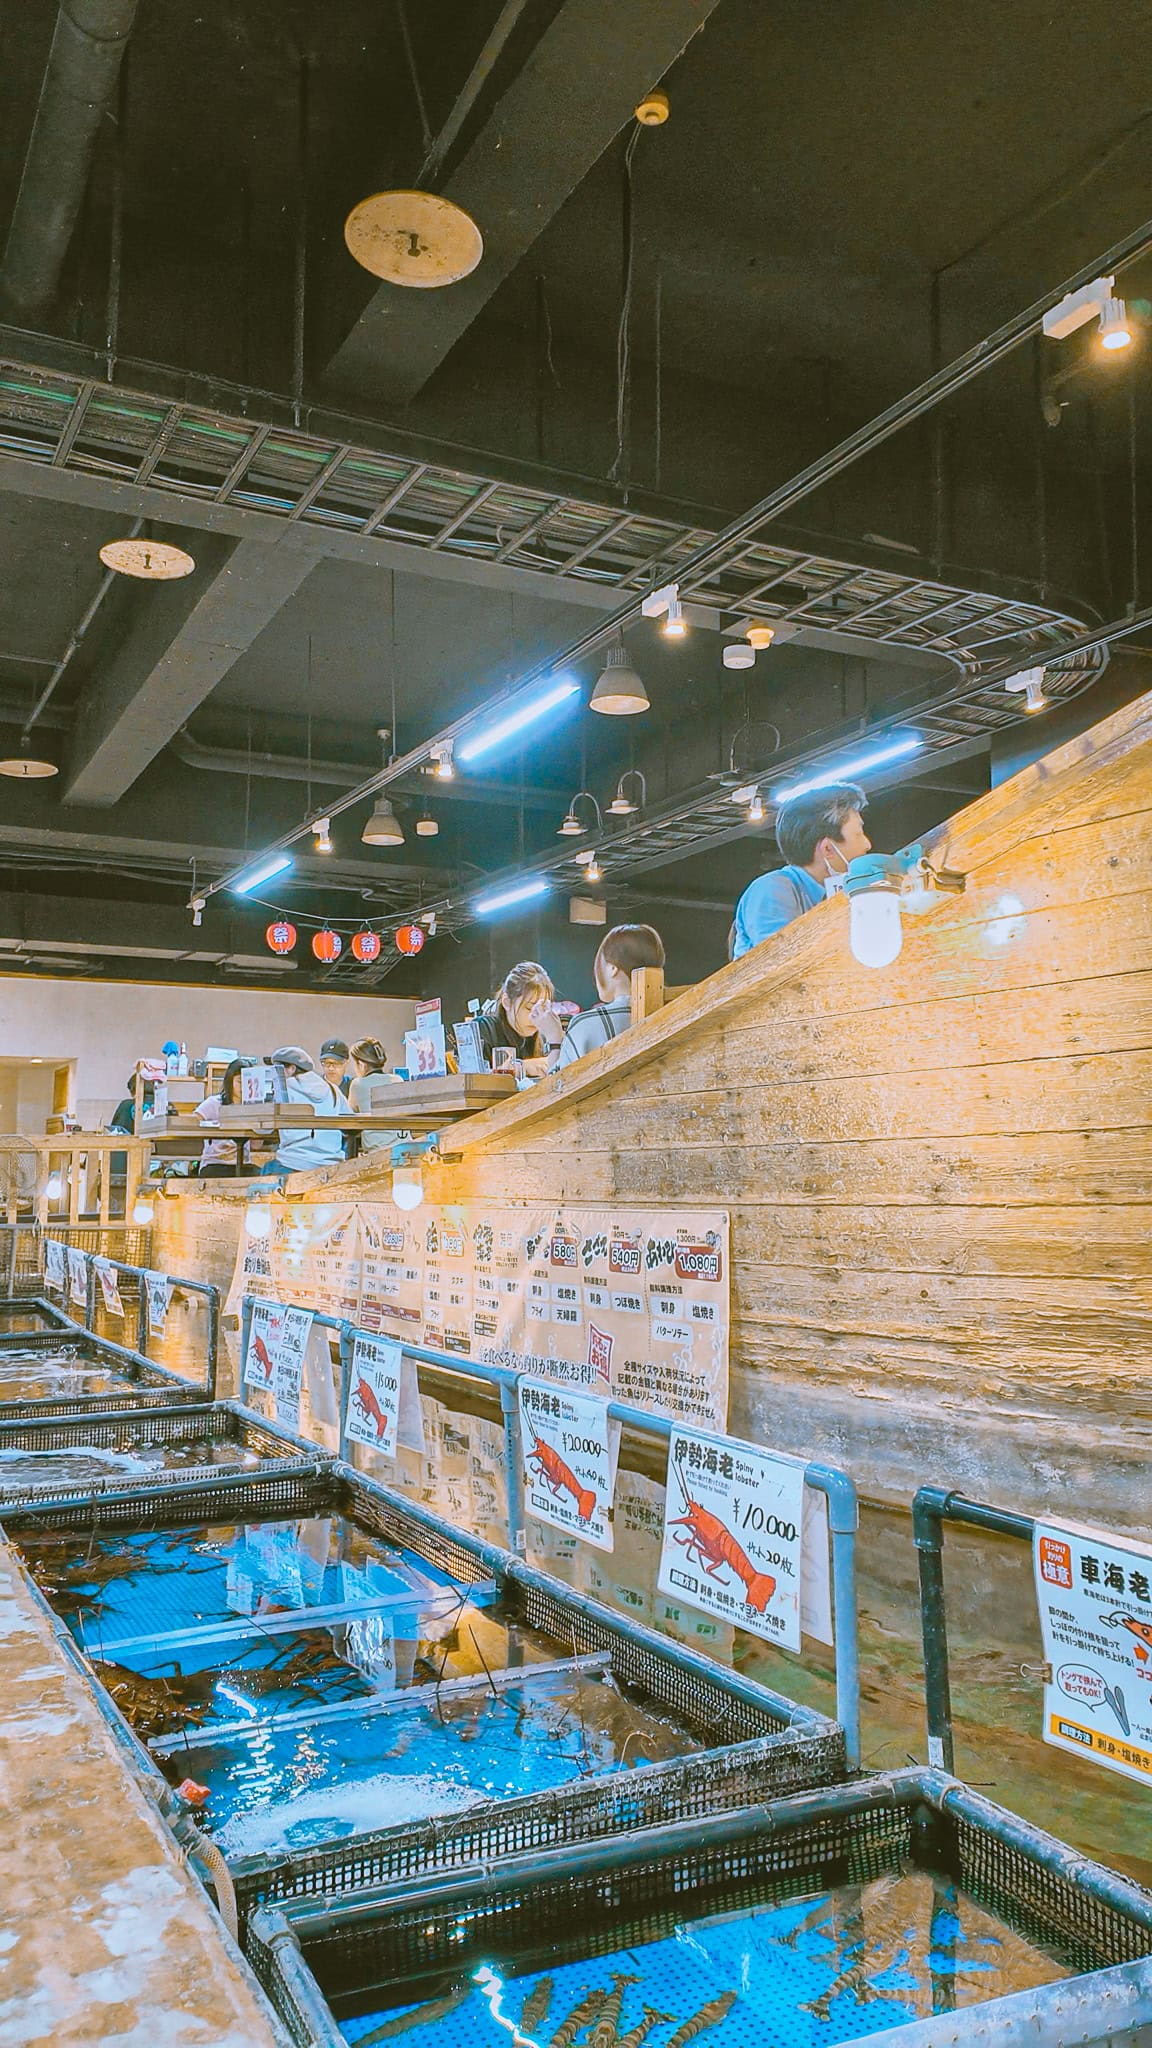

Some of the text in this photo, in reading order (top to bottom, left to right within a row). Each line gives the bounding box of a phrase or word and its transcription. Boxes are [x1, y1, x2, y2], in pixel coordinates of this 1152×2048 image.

[612, 1250, 639, 1267] 540円
[680, 1255, 718, 1273] 1,080円
[556, 1287, 577, 1300] 塩焼き
[660, 1300, 714, 1320] 刺身 塩焼き
[656, 1325, 689, 1339] バターソテー
[522, 1387, 561, 1419] 伊勢海老
[674, 1437, 754, 1481] 伊勢海老 Spiny
[735, 1471, 760, 1489] lobster
[1042, 1559, 1071, 1586] 極意
[1080, 1554, 1151, 1603] 車海老
[1097, 1738, 1151, 1770] 刺身・塩焼き
